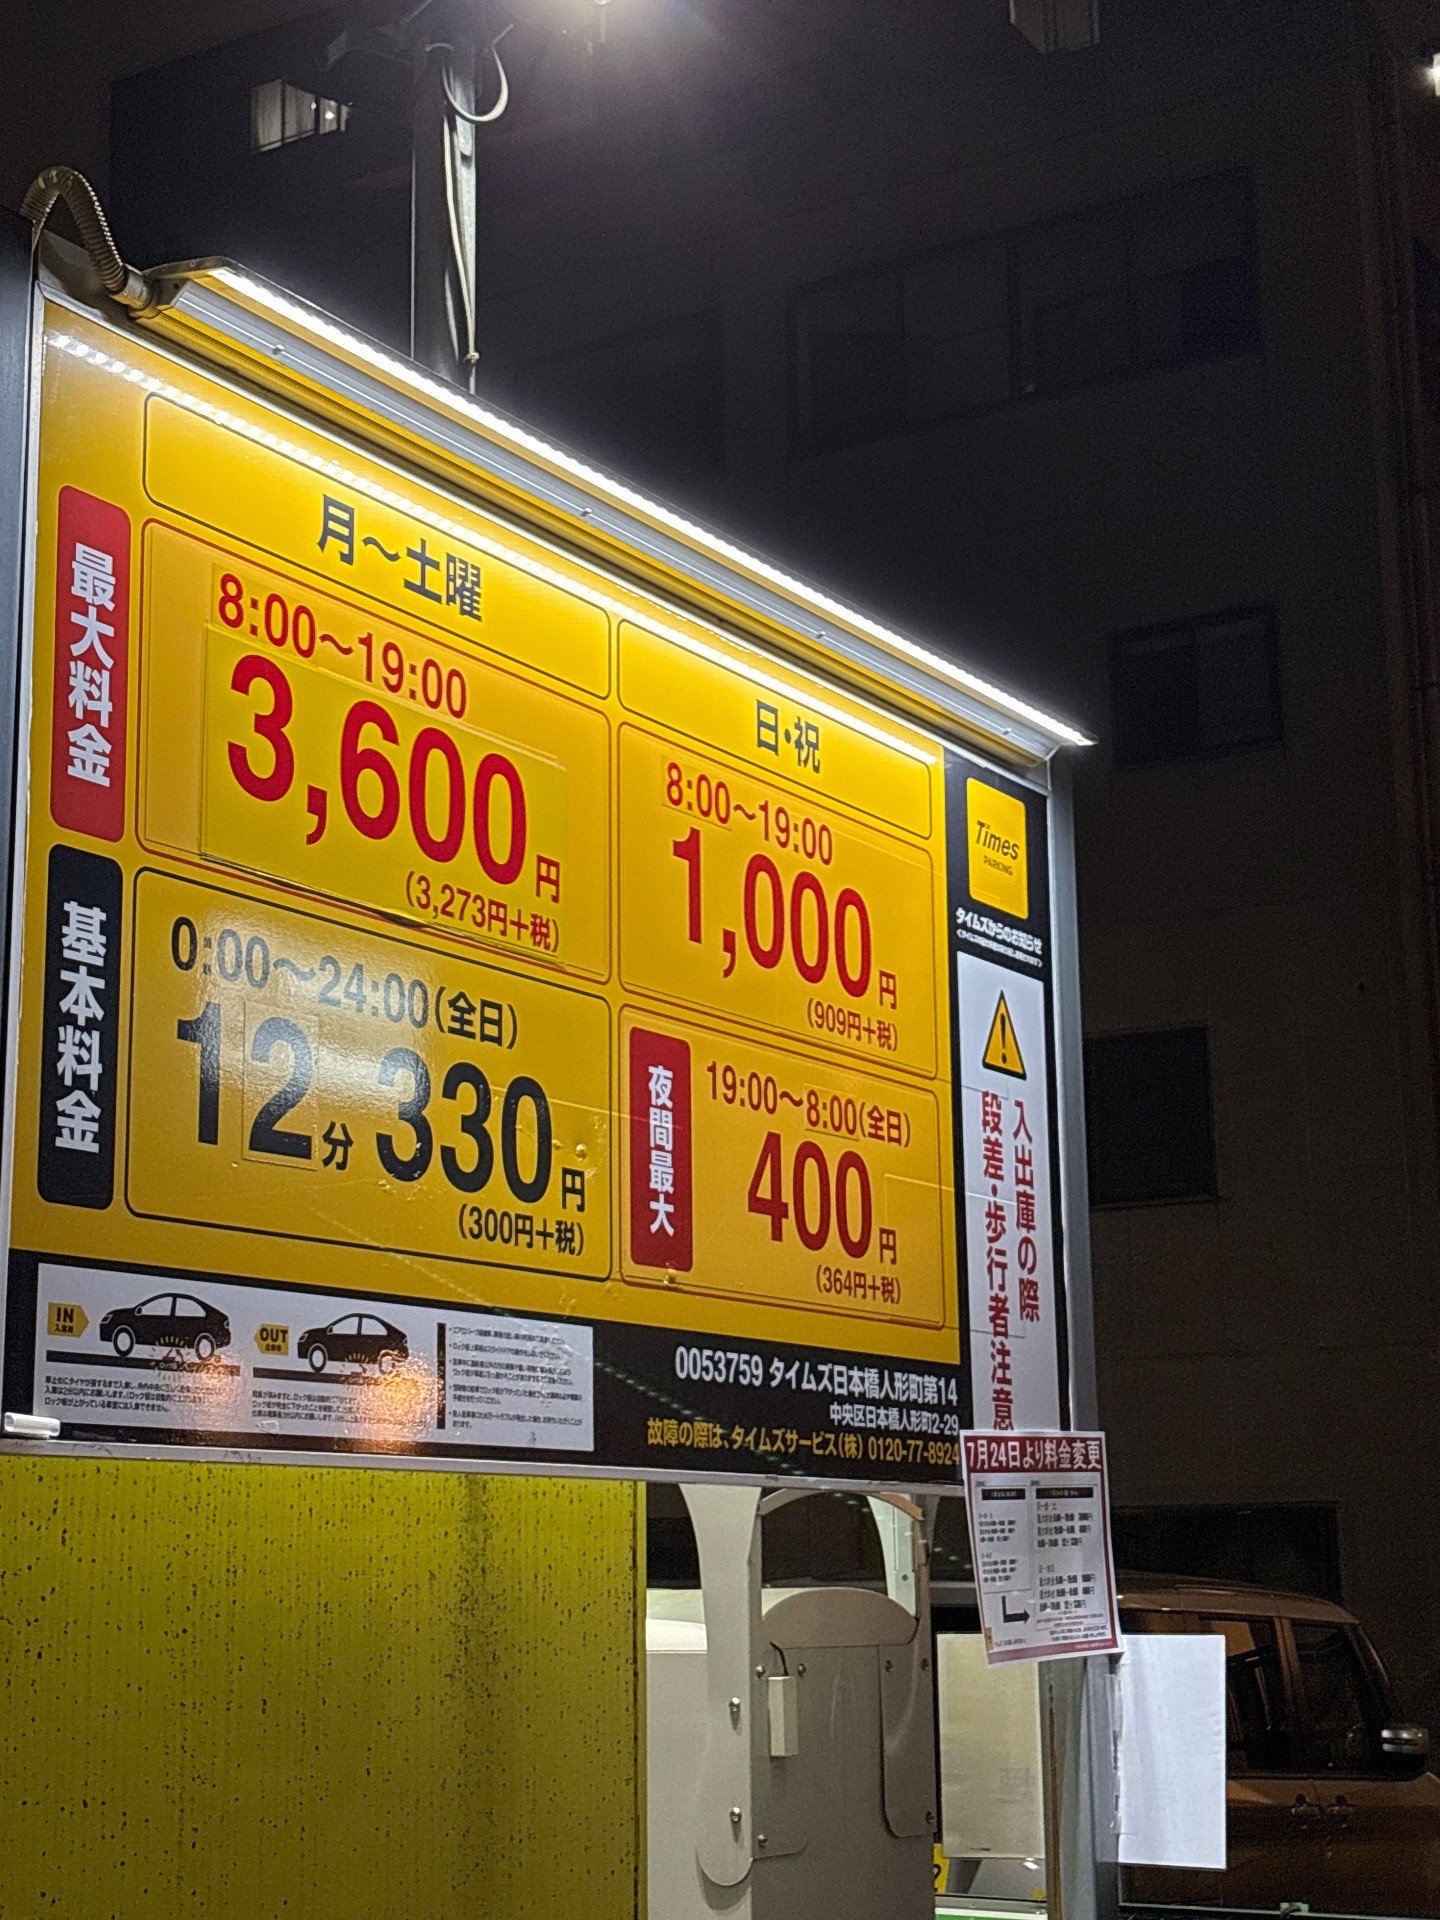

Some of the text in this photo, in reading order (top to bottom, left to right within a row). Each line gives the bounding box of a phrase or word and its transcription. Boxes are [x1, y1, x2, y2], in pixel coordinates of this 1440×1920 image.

[318, 494, 483, 623] 月～土曜
[67, 542, 117, 788] 最大料金
[218, 572, 468, 720] 8:00～19:00
[756, 698, 821, 774] 日・祝
[665, 760, 834, 867] 8:00～19:00
[975, 819, 1020, 861] Times
[983, 854, 1015, 877] PARKING
[55, 900, 108, 1155] 基本料金
[648, 1064, 675, 1238] 夜間最大
[1013, 1098, 1041, 1323] 入出庫の際
[981, 1089, 1014, 1432] 段差・歩行者注意
[57, 1306, 75, 1324] IN
[260, 1327, 289, 1344] OUT
[674, 1345, 959, 1407] 0053759 タイムズ日本橋人形町第14
[829, 1400, 960, 1436] 中央区日本橋人形町2-29
[867, 1438, 960, 1466] 0120-77-8924
[966, 1438, 1103, 1471] 7月24日より料金変更
